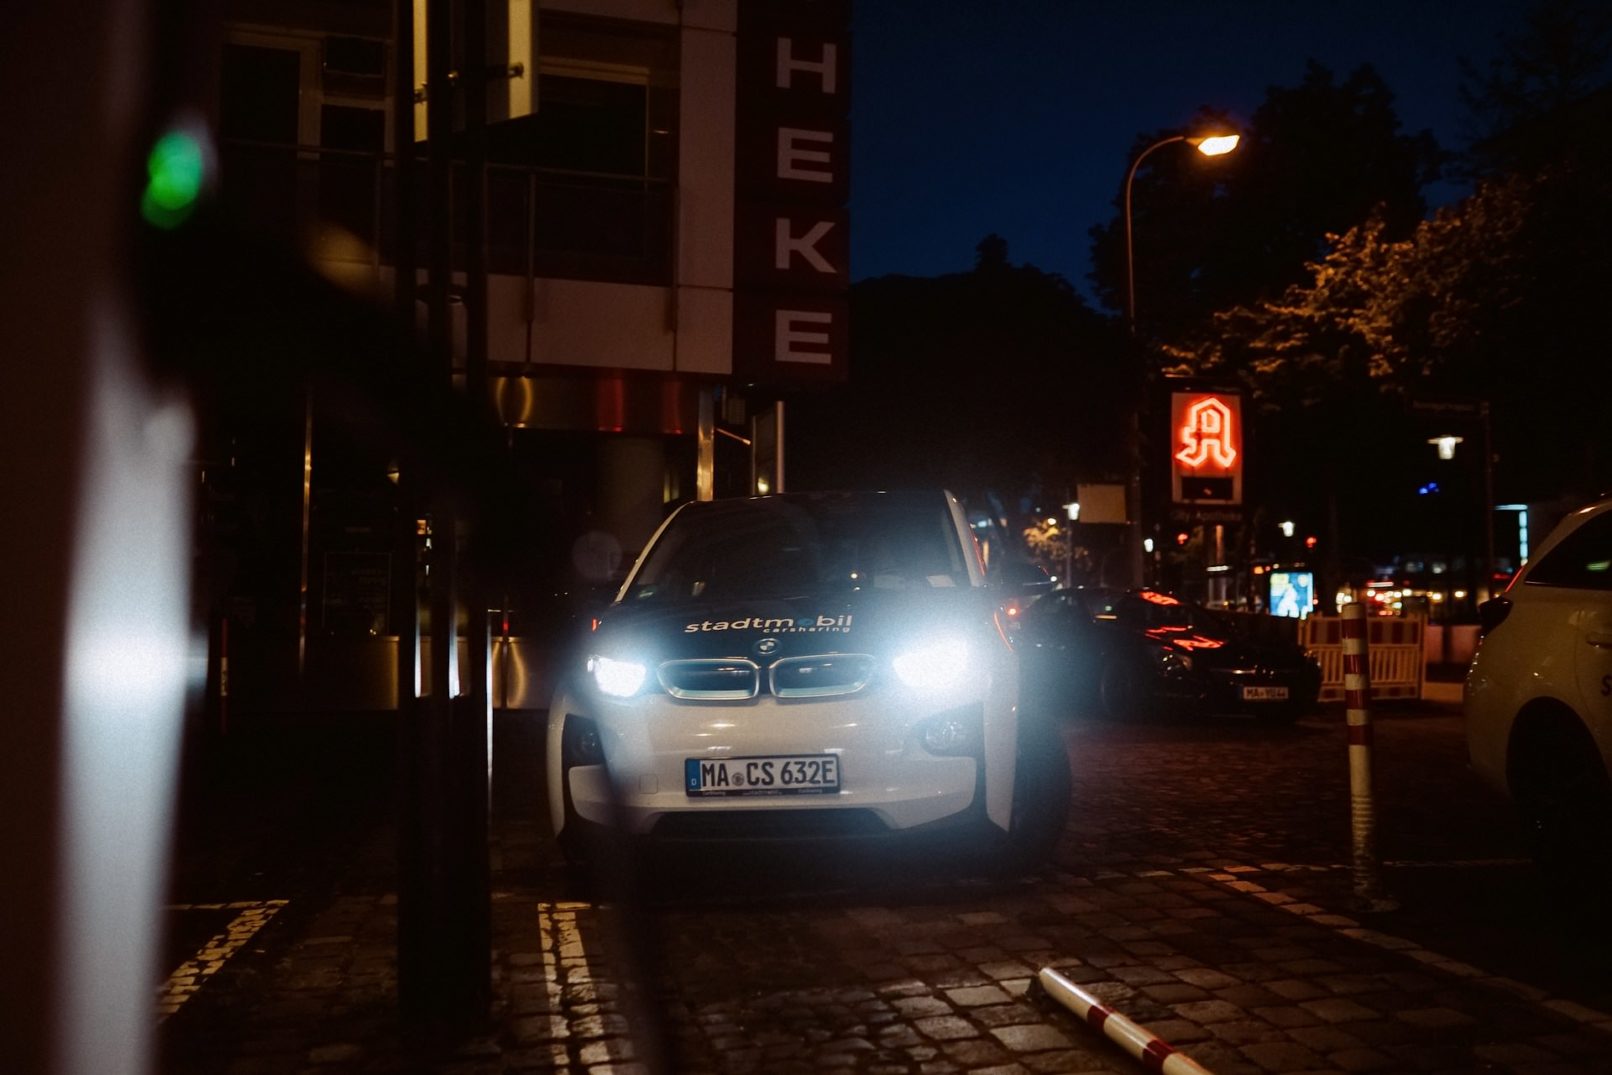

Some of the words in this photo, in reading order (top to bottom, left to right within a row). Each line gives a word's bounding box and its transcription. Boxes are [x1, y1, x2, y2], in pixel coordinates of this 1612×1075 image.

[684, 615, 853, 633] stadtmobil
[702, 763, 730, 787] MA
[746, 762, 774, 786] CS
[780, 761, 836, 785] 632E
